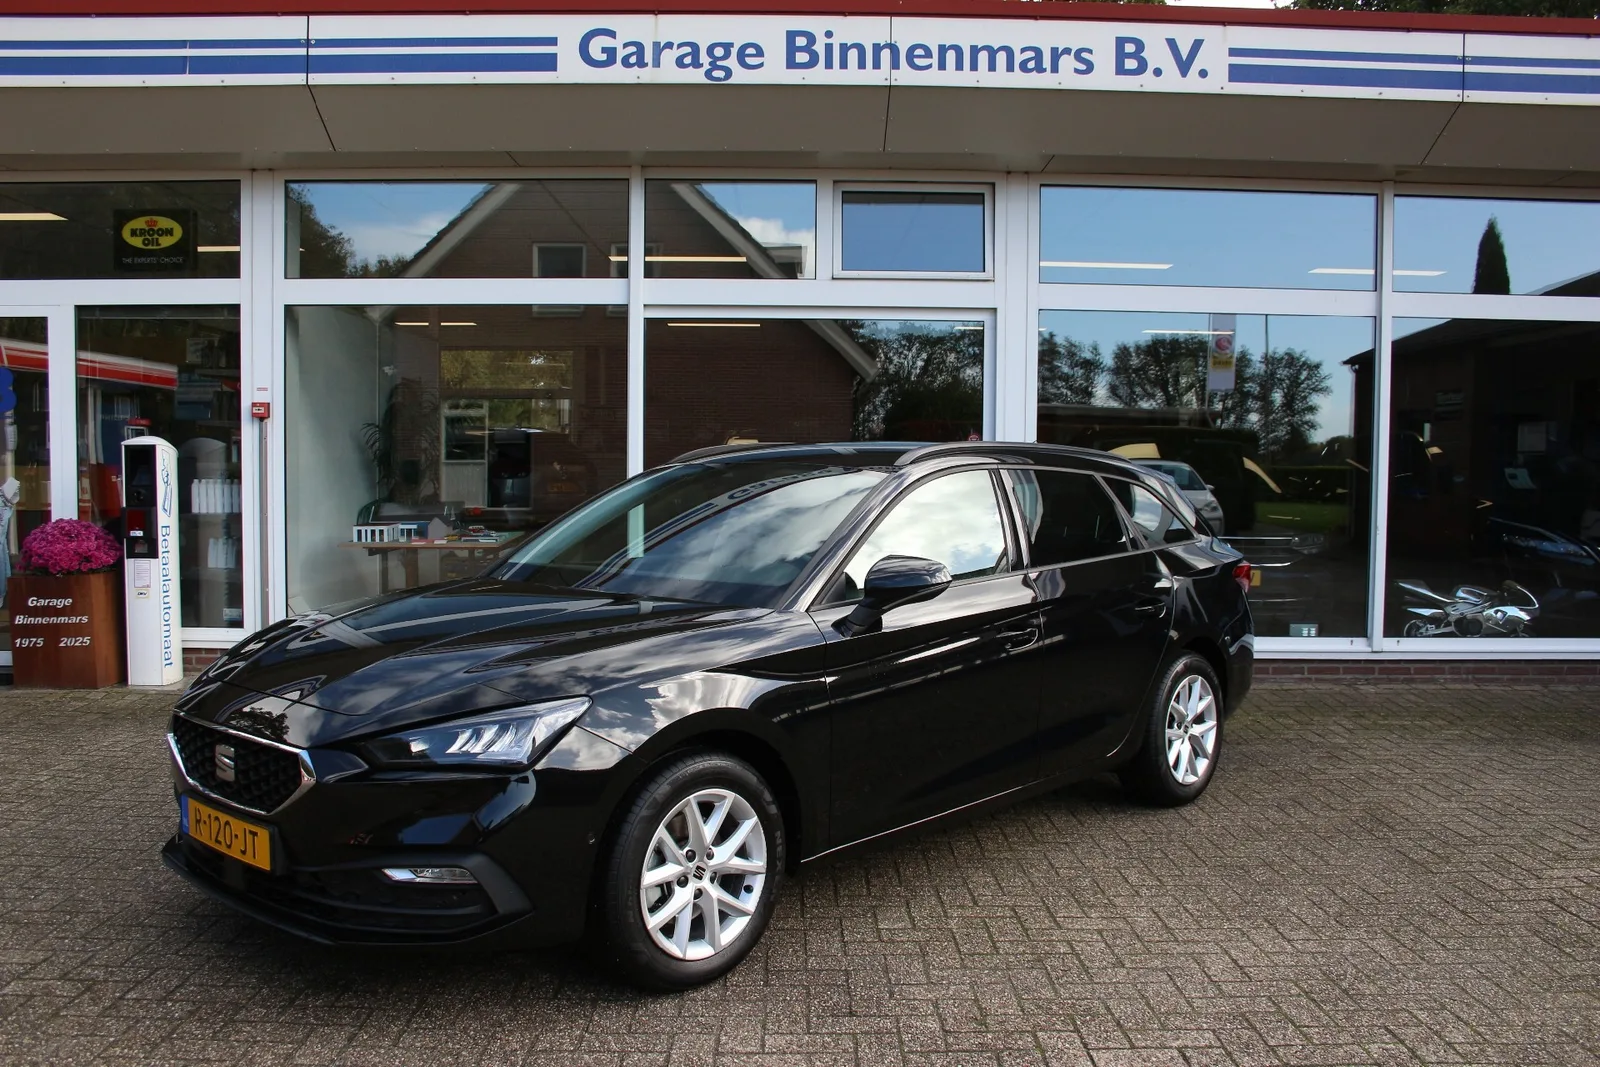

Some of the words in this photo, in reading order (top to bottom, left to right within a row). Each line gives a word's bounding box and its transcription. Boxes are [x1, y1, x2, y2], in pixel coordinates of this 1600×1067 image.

[577, 27, 766, 83] Garage
[786, 29, 1096, 76] Binnenmars
[1114, 36, 1210, 79] B.V.
[130, 227, 174, 237] KROON
[141, 237, 162, 247] OIL
[159, 256, 184, 264] CHOICE
[27, 596, 73, 609] Garage
[160, 525, 174, 668] Betaalautomaat
[14, 614, 89, 625] Binnenmars
[14, 637, 45, 648] 1975
[58, 636, 91, 648] 2025
[195, 807, 259, 859] R-120-JT
